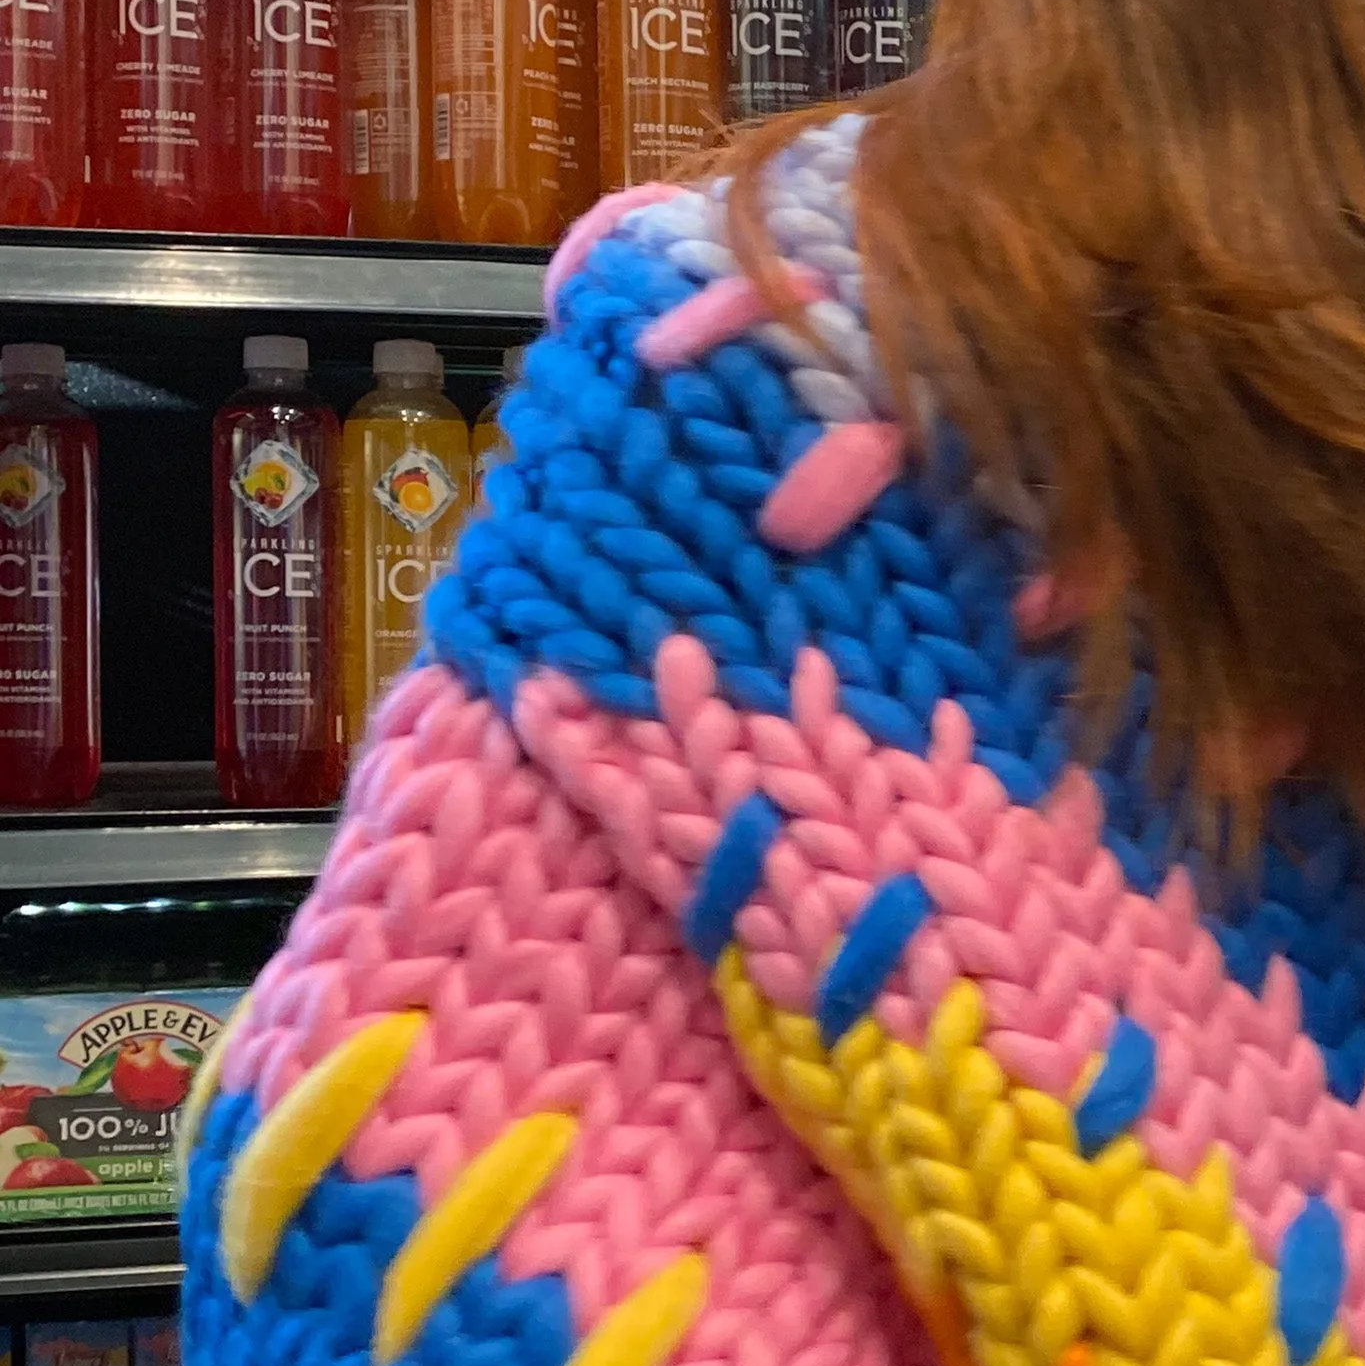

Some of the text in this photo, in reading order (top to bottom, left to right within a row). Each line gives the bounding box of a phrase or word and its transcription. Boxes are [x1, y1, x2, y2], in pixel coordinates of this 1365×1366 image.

[629, 6, 706, 55] ICE
[731, 11, 804, 56] ICE
[841, 21, 904, 65] ICE
[120, 109, 197, 123] ZERO SUGAR
[255, 115, 330, 130] ZERO SUGAR
[633, 122, 704, 136] ZERO SUGAR
[241, 538, 317, 550] PARKLING
[271, 624, 307, 633] PUNCH
[16, 670, 58, 680] SUGAR
[271, 671, 311, 682] SUGAR
[82, 1009, 180, 1063] APPLE &
[59, 1115, 148, 1141] 100%
[99, 1159, 153, 1178] apple
